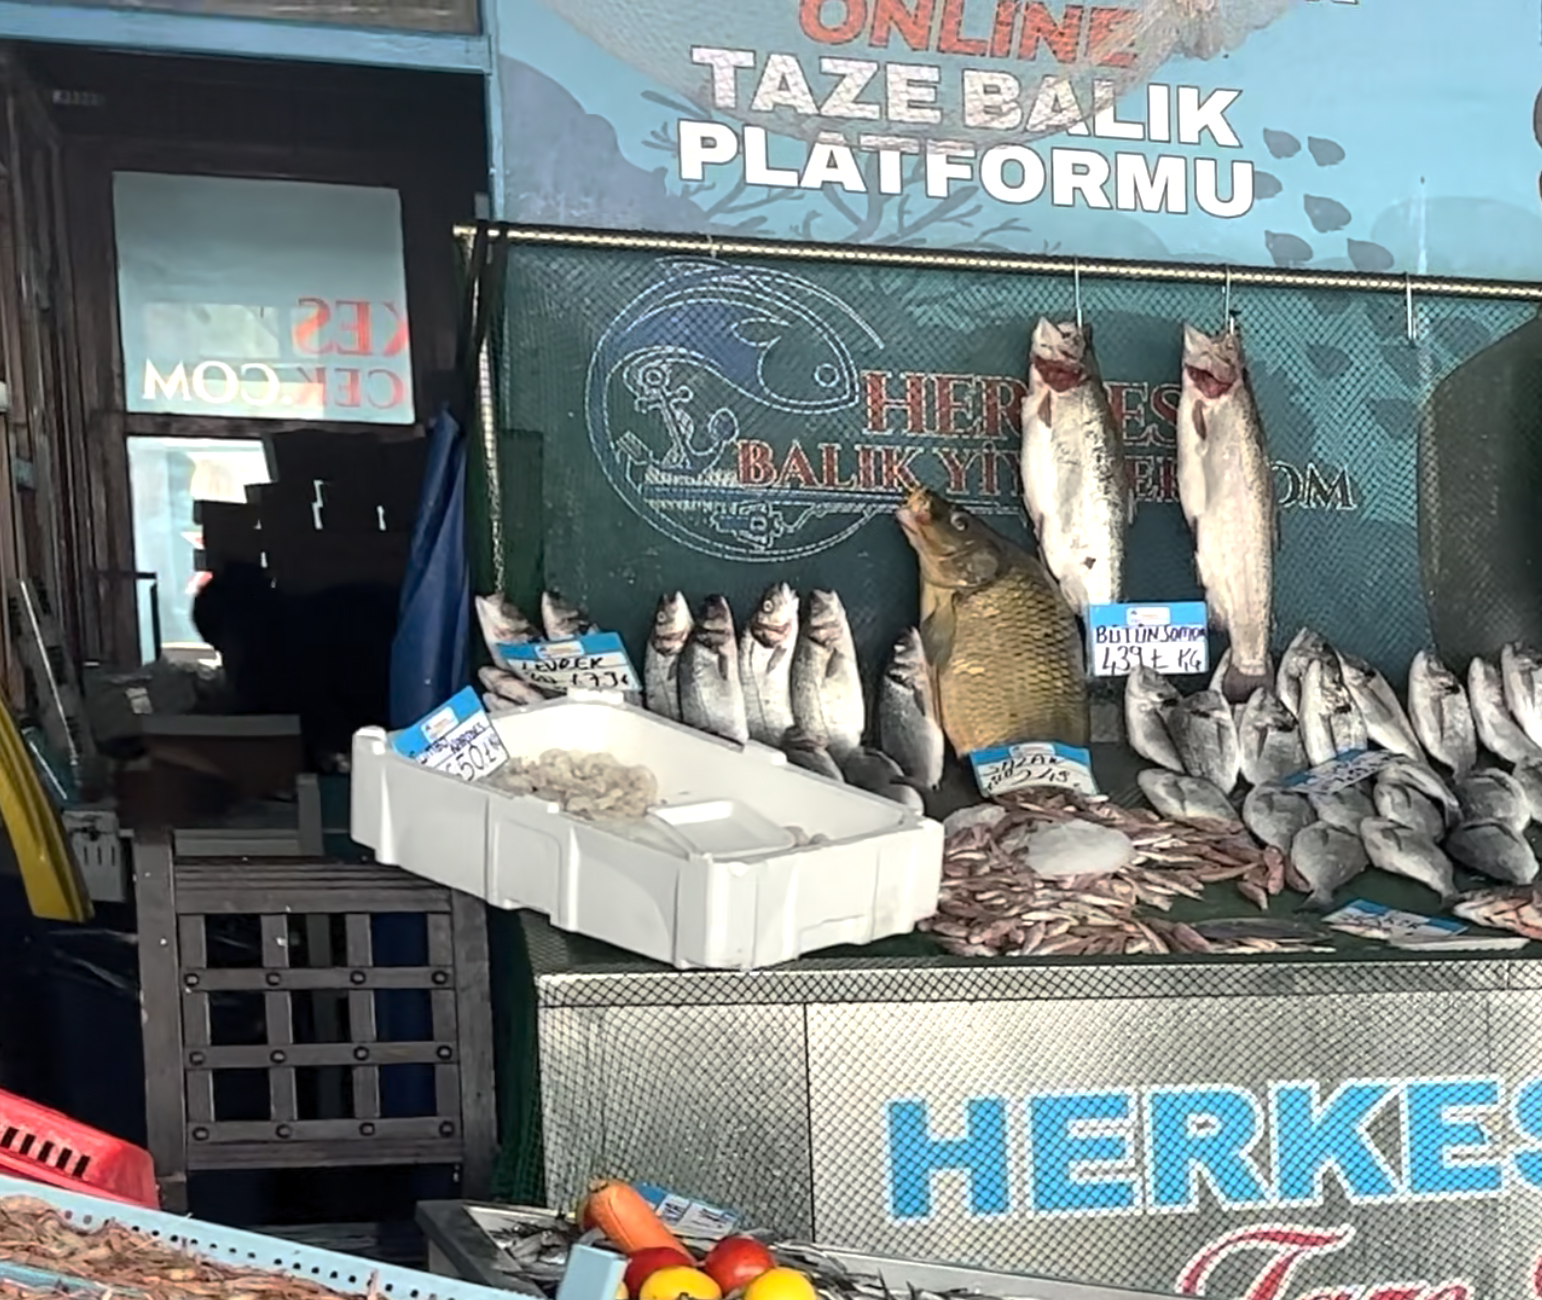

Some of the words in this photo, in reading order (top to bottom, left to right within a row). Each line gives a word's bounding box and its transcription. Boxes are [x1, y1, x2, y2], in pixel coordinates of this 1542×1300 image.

[691, 46, 942, 125] TAZE
[961, 67, 1243, 148] BALIK
[677, 119, 1255, 218] PLATFORMU
[861, 370, 1182, 443] HERES
[737, 439, 925, 492] BALIK
